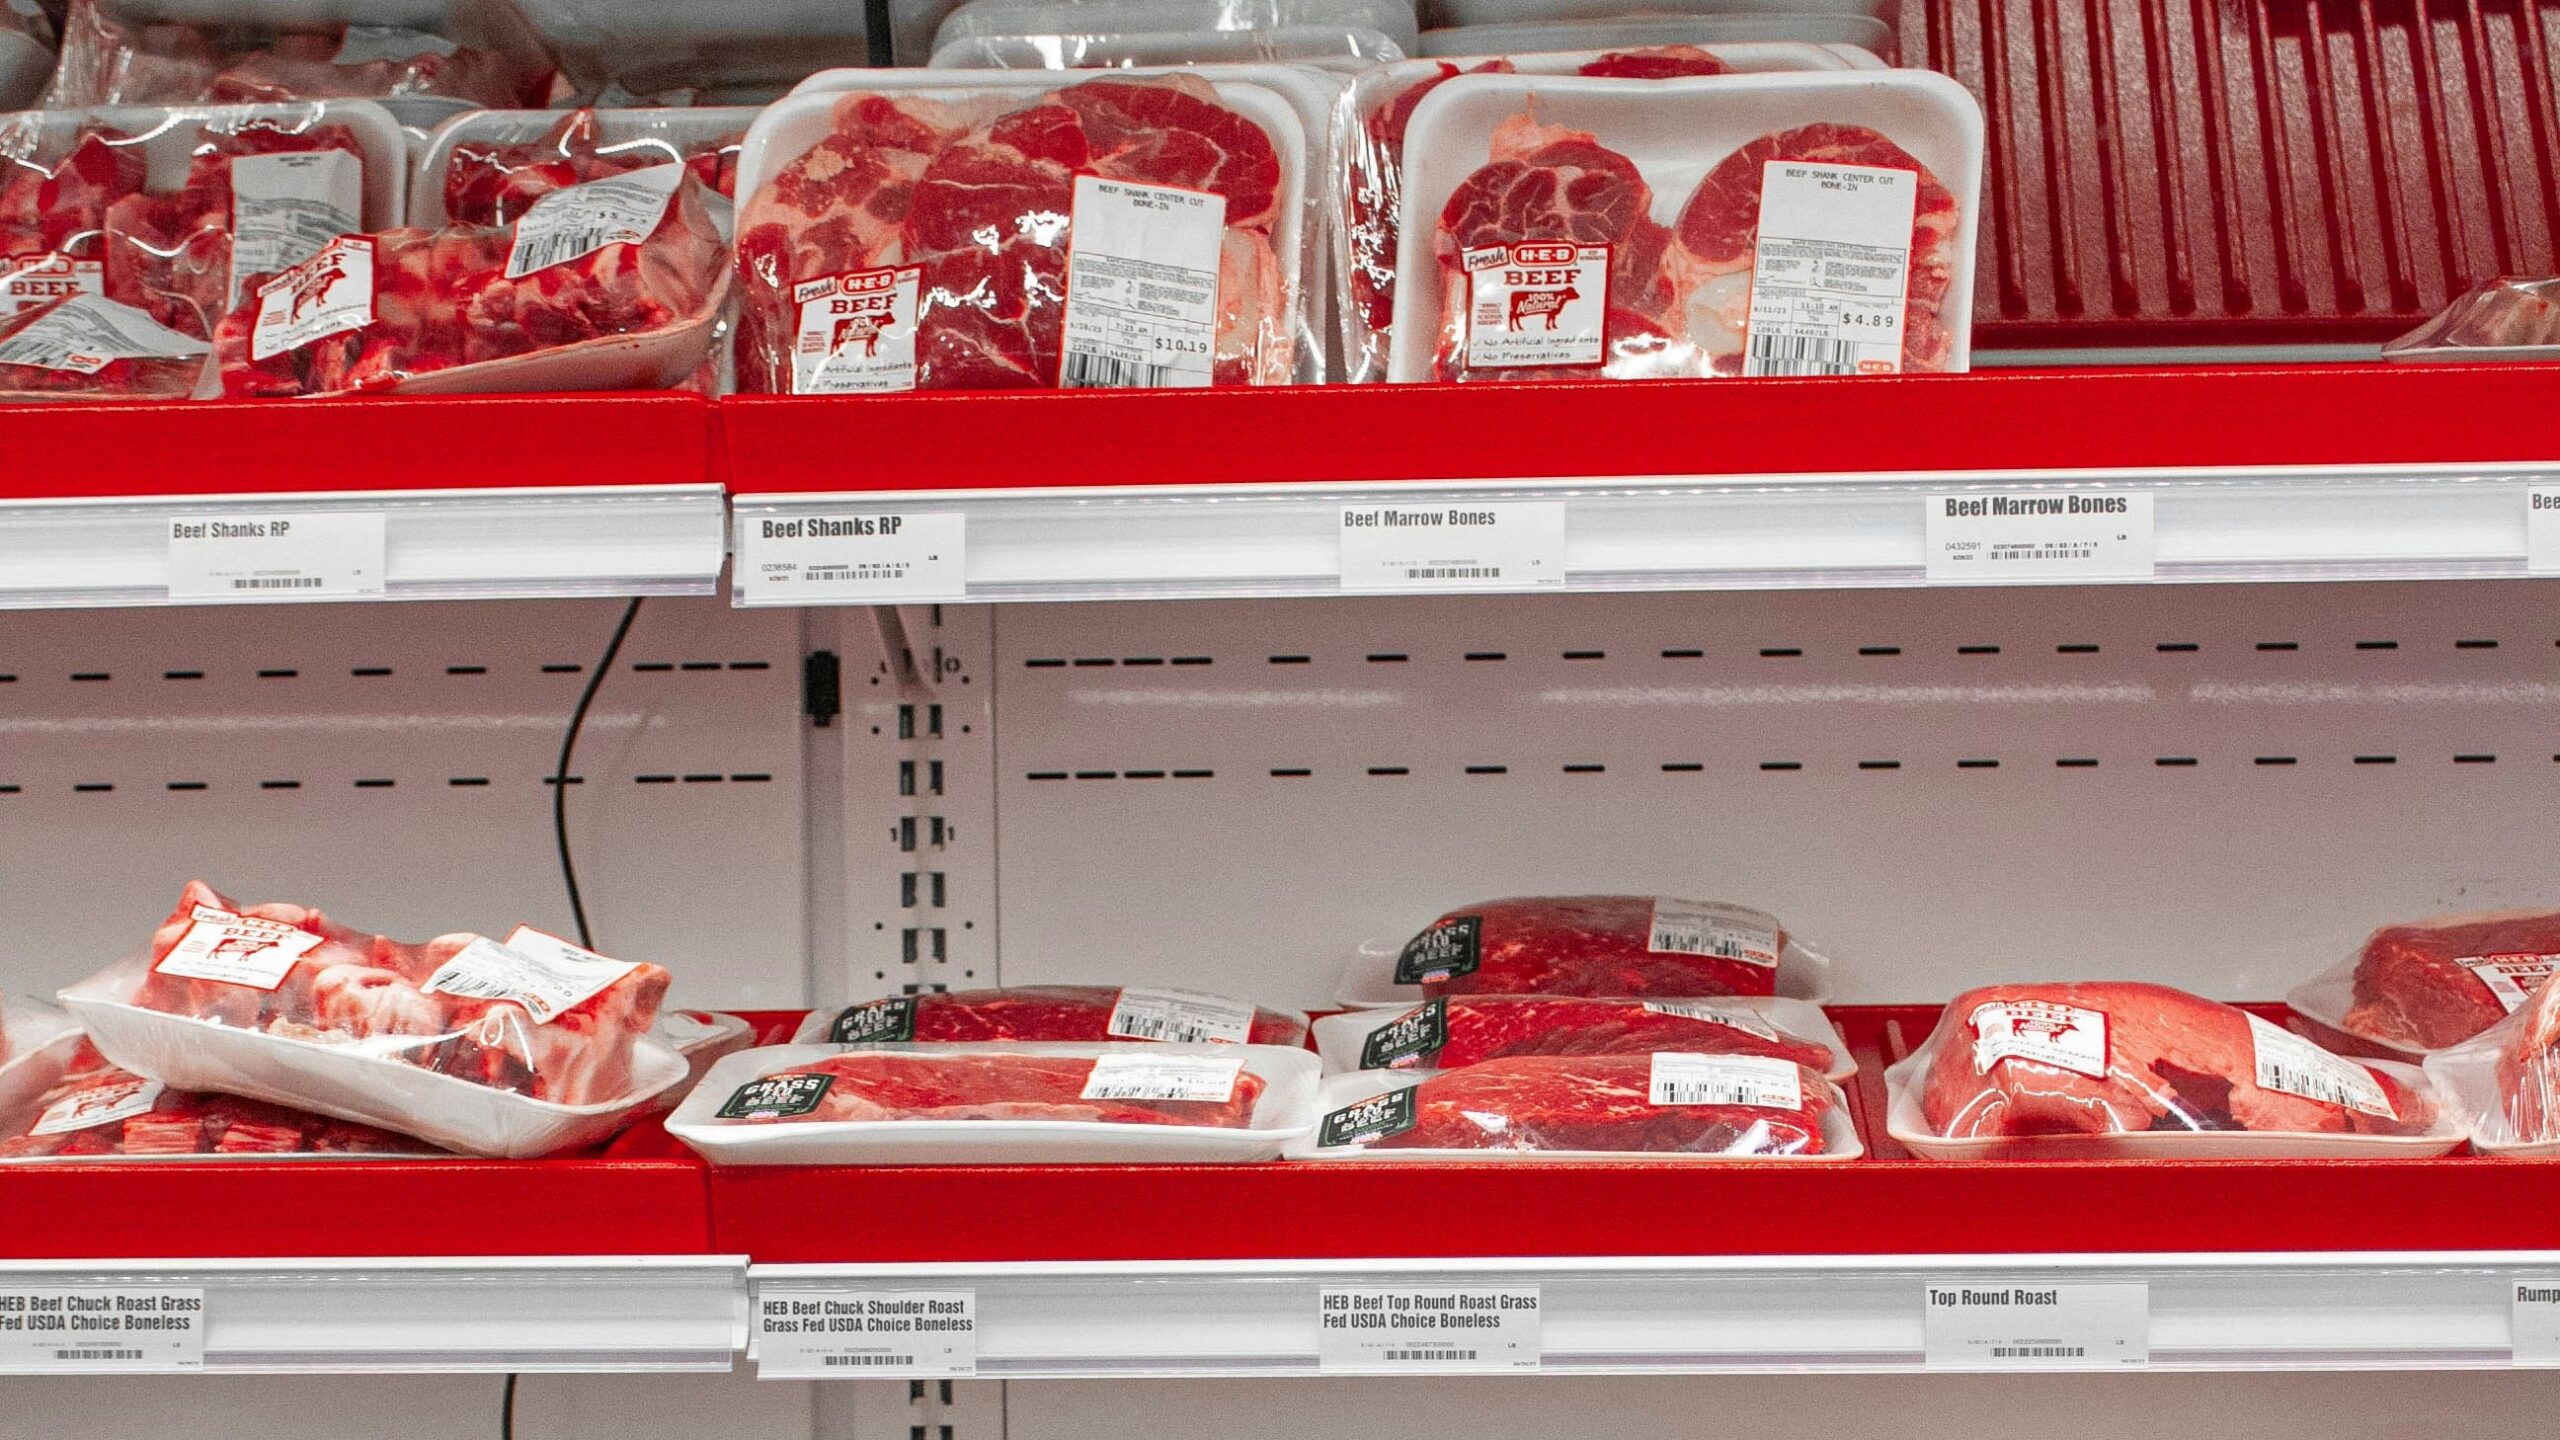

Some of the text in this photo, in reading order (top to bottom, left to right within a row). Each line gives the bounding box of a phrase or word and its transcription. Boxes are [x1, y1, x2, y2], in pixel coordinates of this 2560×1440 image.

[1785, 168, 1894, 185] BEEF SHANK CENTER CUT
[1820, 181, 1858, 192] BONE-IN
[1154, 192, 1185, 205] CENTER
[1188, 197, 1205, 208] CUT
[1467, 247, 1505, 268] Fresh
[1503, 269, 1582, 286] BEEF
[10, 280, 80, 296] BEEF
[829, 293, 898, 314] BEEF
[1842, 312, 1894, 328] $4.89
[1154, 335, 1208, 354] $10.19
[1344, 509, 1496, 527] Beef Marrow Bones
[173, 521, 290, 539] Beef Shanks RP
[761, 516, 902, 539] Beef Shanks RP
[222, 927, 291, 940] BEEF
[744, 1078, 820, 1096] GRASS
[0, 1295, 201, 1312] HEB Beef Chuck Roast Grass
[1323, 1294, 1537, 1312] HEB Beef Top Round Roast Grass
[1929, 1289, 2058, 1307] Top Round Roast
[2517, 1286, 2560, 1304] Rump
[763, 1300, 965, 1315] HEB Beef Chuck Shoulder Roast
[0, 1314, 191, 1331] Fed USDA Choice Boneless
[763, 1316, 973, 1333] Grass Fed USDA Choice Boneless
[1323, 1313, 1501, 1329] Fed USDA Choice Boneless
